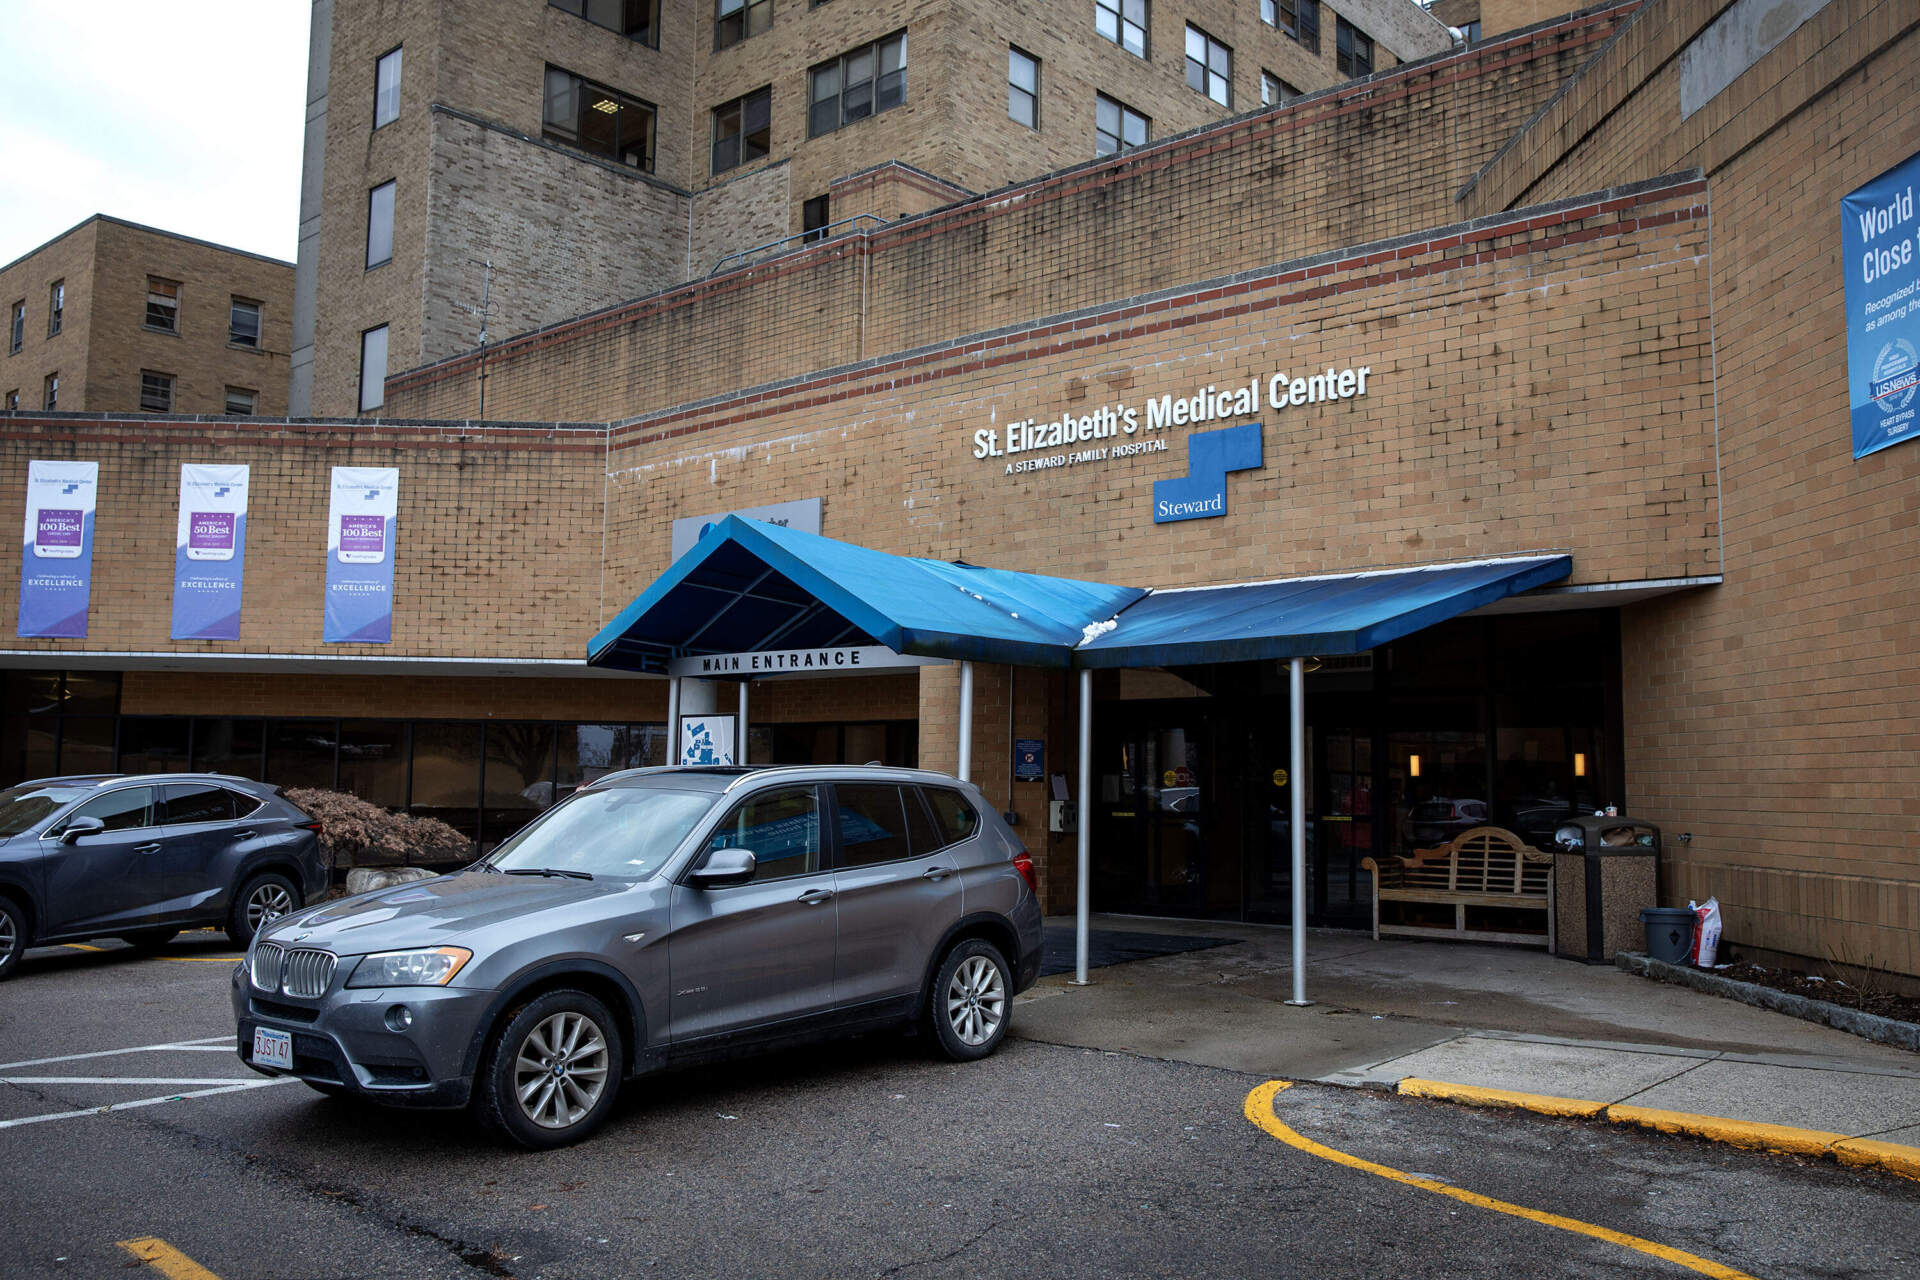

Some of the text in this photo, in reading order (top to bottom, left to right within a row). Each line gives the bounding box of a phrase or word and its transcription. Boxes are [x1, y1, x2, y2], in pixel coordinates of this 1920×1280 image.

[1859, 185, 1914, 243] World
[1862, 238, 1912, 284] Close
[1865, 281, 1915, 316] Recognized
[1865, 320, 1876, 332] as
[1877, 305, 1906, 328] among
[973, 366, 1371, 459] St. Elizabeth's Medical Center
[1887, 421, 1909, 436] SURGERY
[1005, 439, 1169, 475] A STEWARD FAMILY HOSPITAL
[1159, 493, 1222, 517] Steward
[40, 522, 81, 532] 100 Best
[194, 525, 230, 534] 50 Best
[342, 528, 382, 537] 100 Best
[28, 578, 84, 587] EXCELLENCE
[181, 581, 236, 589] EXCELLENCE
[332, 584, 387, 592] EXCELLENCE
[703, 651, 860, 671] MAIN ENTRANCE
